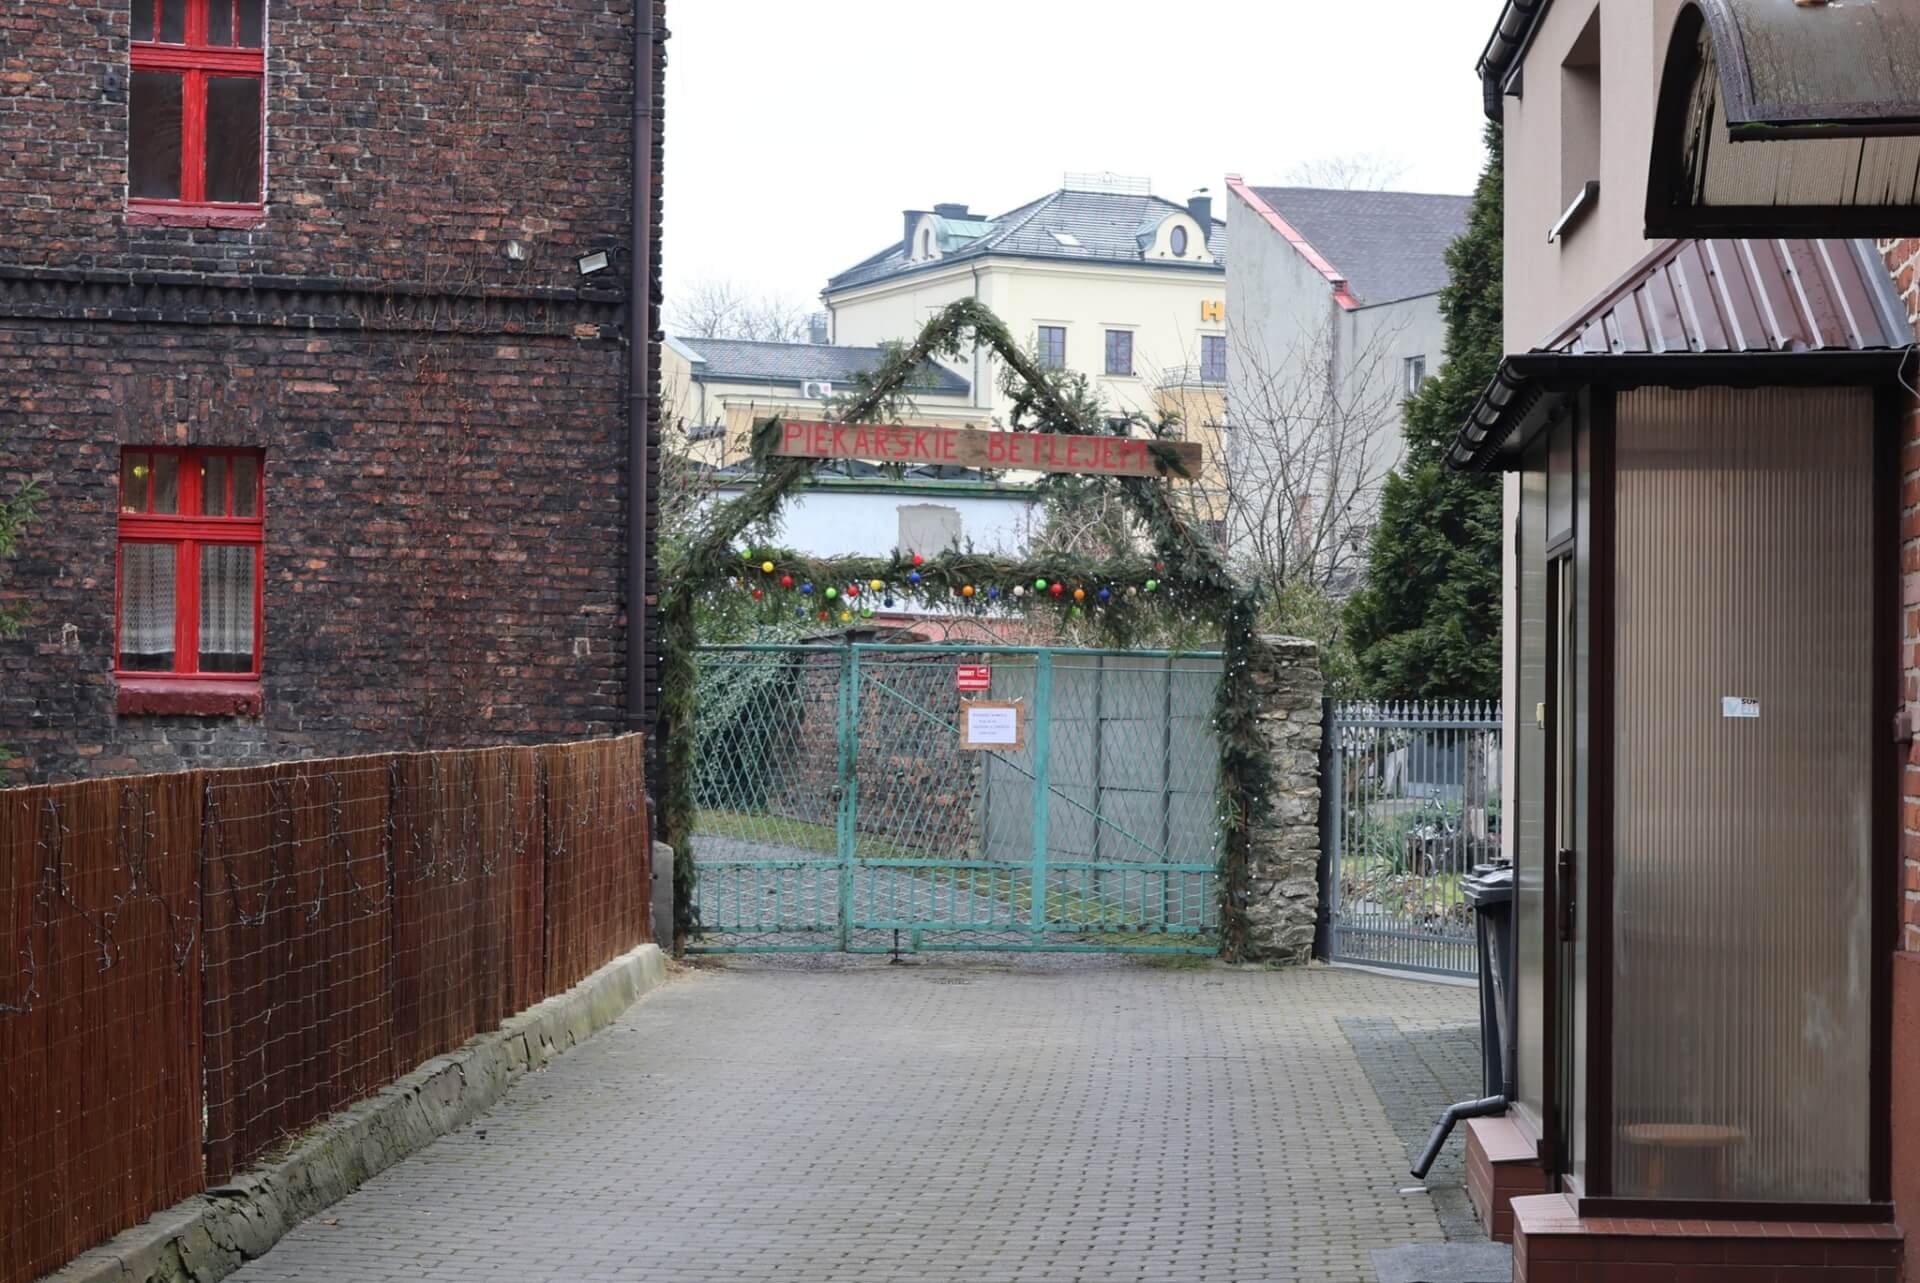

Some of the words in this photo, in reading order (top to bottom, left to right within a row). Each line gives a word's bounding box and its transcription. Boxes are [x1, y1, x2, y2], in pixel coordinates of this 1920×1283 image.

[1201, 298, 1225, 321] H
[783, 422, 961, 460] PIEKARSKIE
[988, 431, 1149, 471] BETLEJEM
